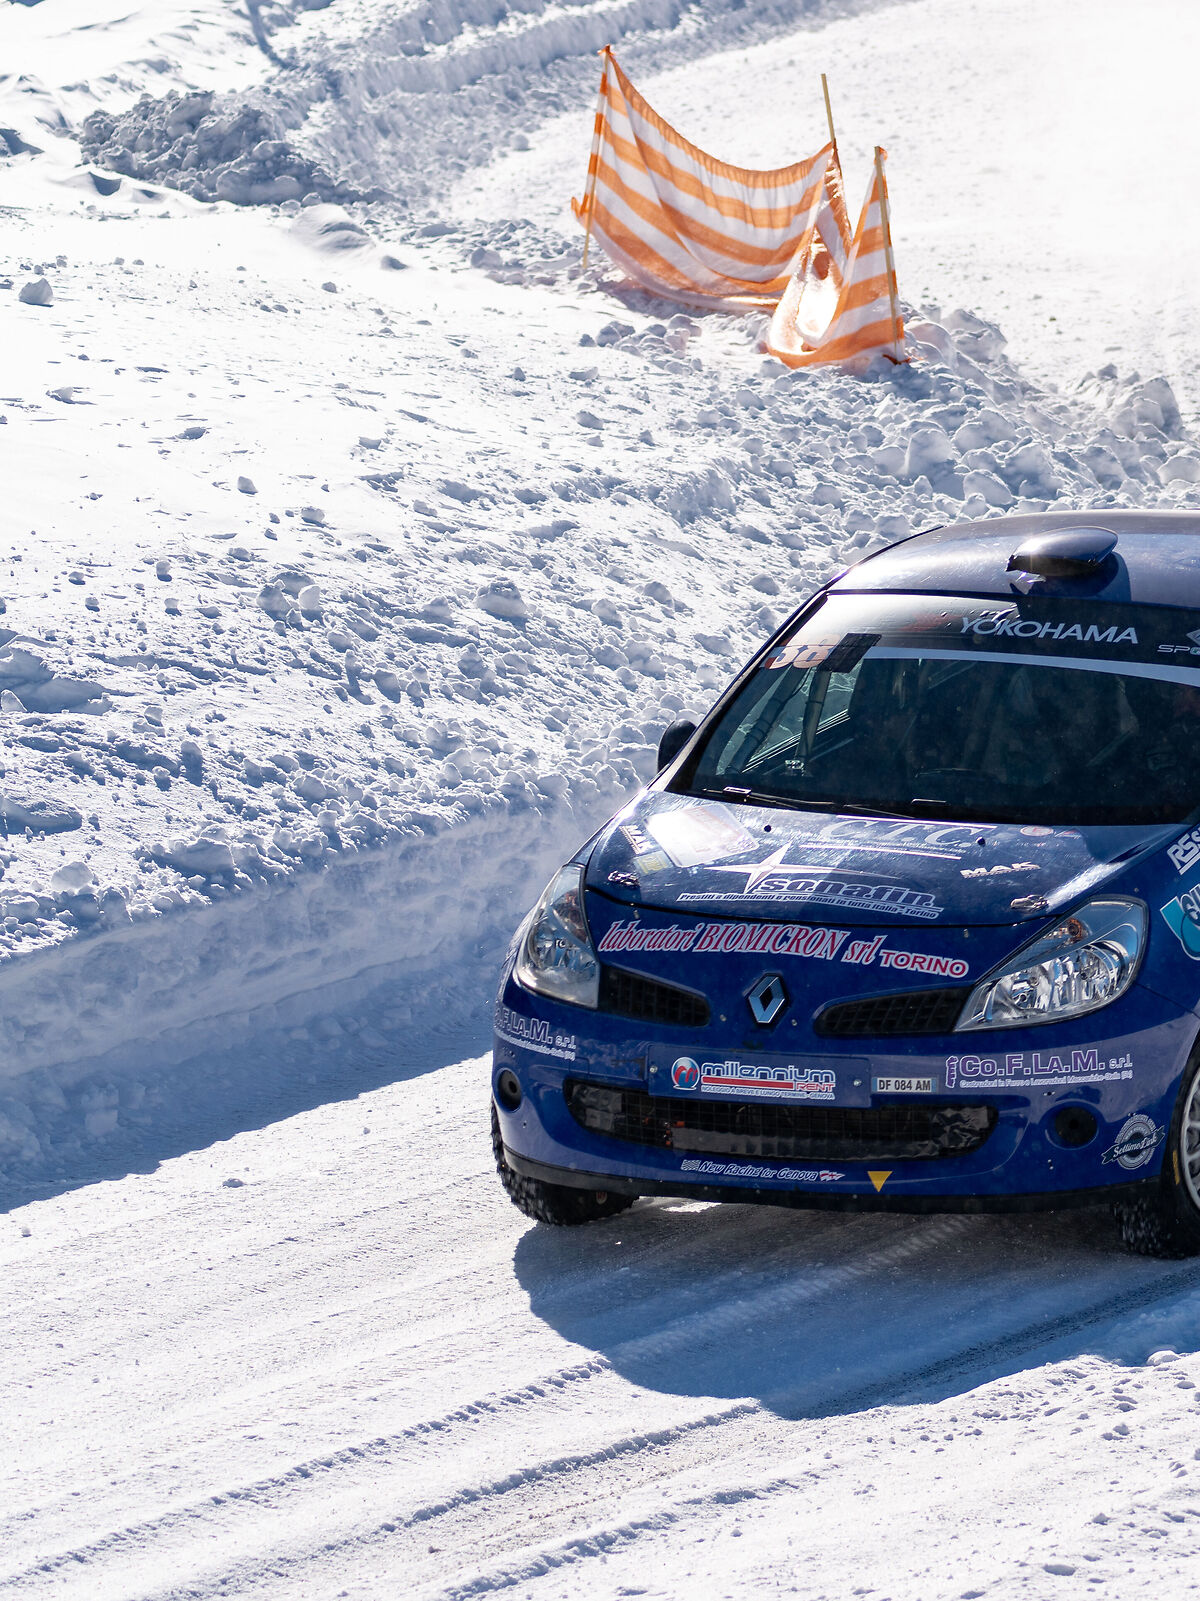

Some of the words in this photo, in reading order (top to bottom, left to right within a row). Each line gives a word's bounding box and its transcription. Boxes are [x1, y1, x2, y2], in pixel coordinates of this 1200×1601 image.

[960, 617, 1138, 644] YOKOHAMA
[960, 862, 1041, 879] MAK
[723, 893, 775, 902] dipendenti
[905, 908, 938, 920] Torino
[600, 920, 700, 952] laboratori
[693, 923, 851, 959] BIOMICRON
[841, 935, 887, 965] srl
[878, 950, 969, 977] TORINO
[701, 1061, 836, 1083] millennium
[1109, 1053, 1133, 1069] s.r.l.
[796, 1082, 835, 1092] RENT
[878, 1079, 892, 1091] DF
[894, 1080, 913, 1091] 084
[915, 1081, 931, 1092] AM
[700, 1160, 724, 1174] New
[723, 1163, 762, 1177] Racing
[761, 1167, 777, 1179] for
[777, 1167, 819, 1182] Genova
